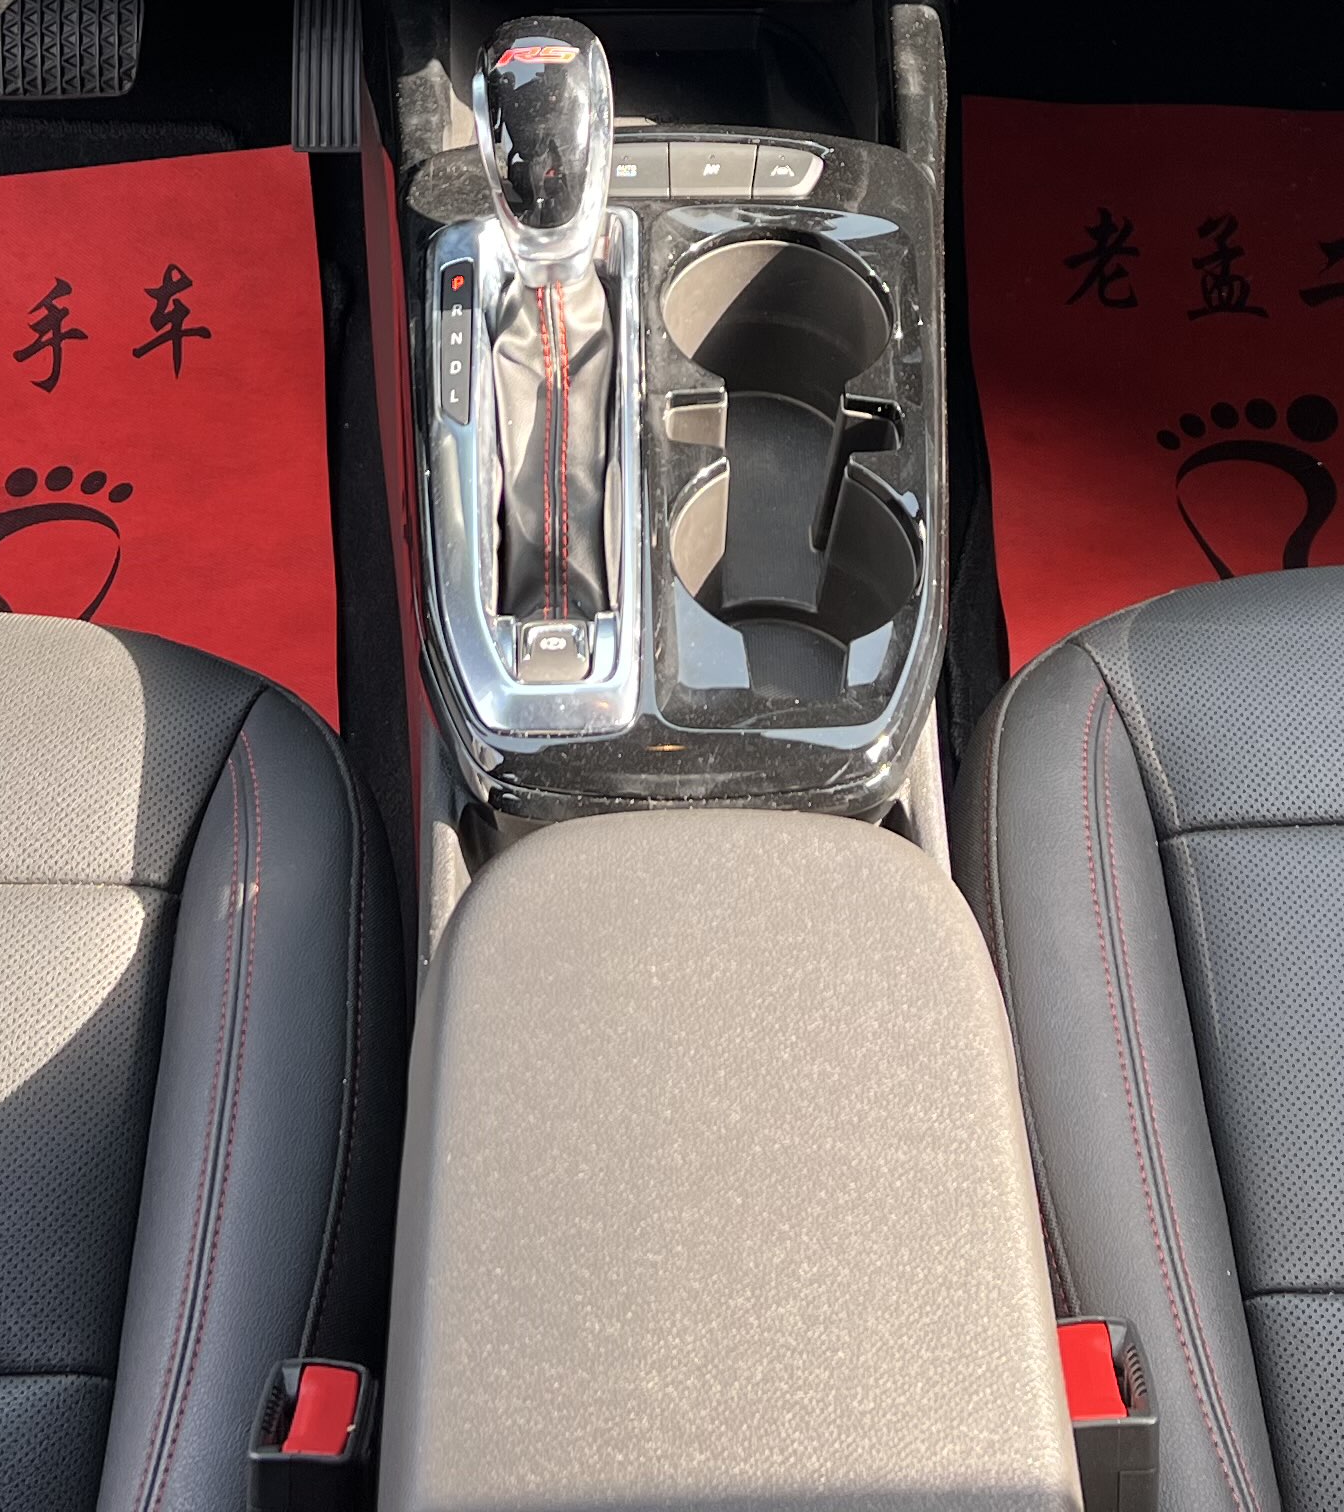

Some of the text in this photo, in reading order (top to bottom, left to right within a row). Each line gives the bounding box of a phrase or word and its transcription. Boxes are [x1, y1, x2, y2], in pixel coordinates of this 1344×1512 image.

[497, 45, 580, 67] RS
[451, 275, 465, 292] P
[451, 303, 463, 317] R
[450, 332, 463, 345] N
[450, 360, 462, 375] D
[449, 389, 459, 403] L
